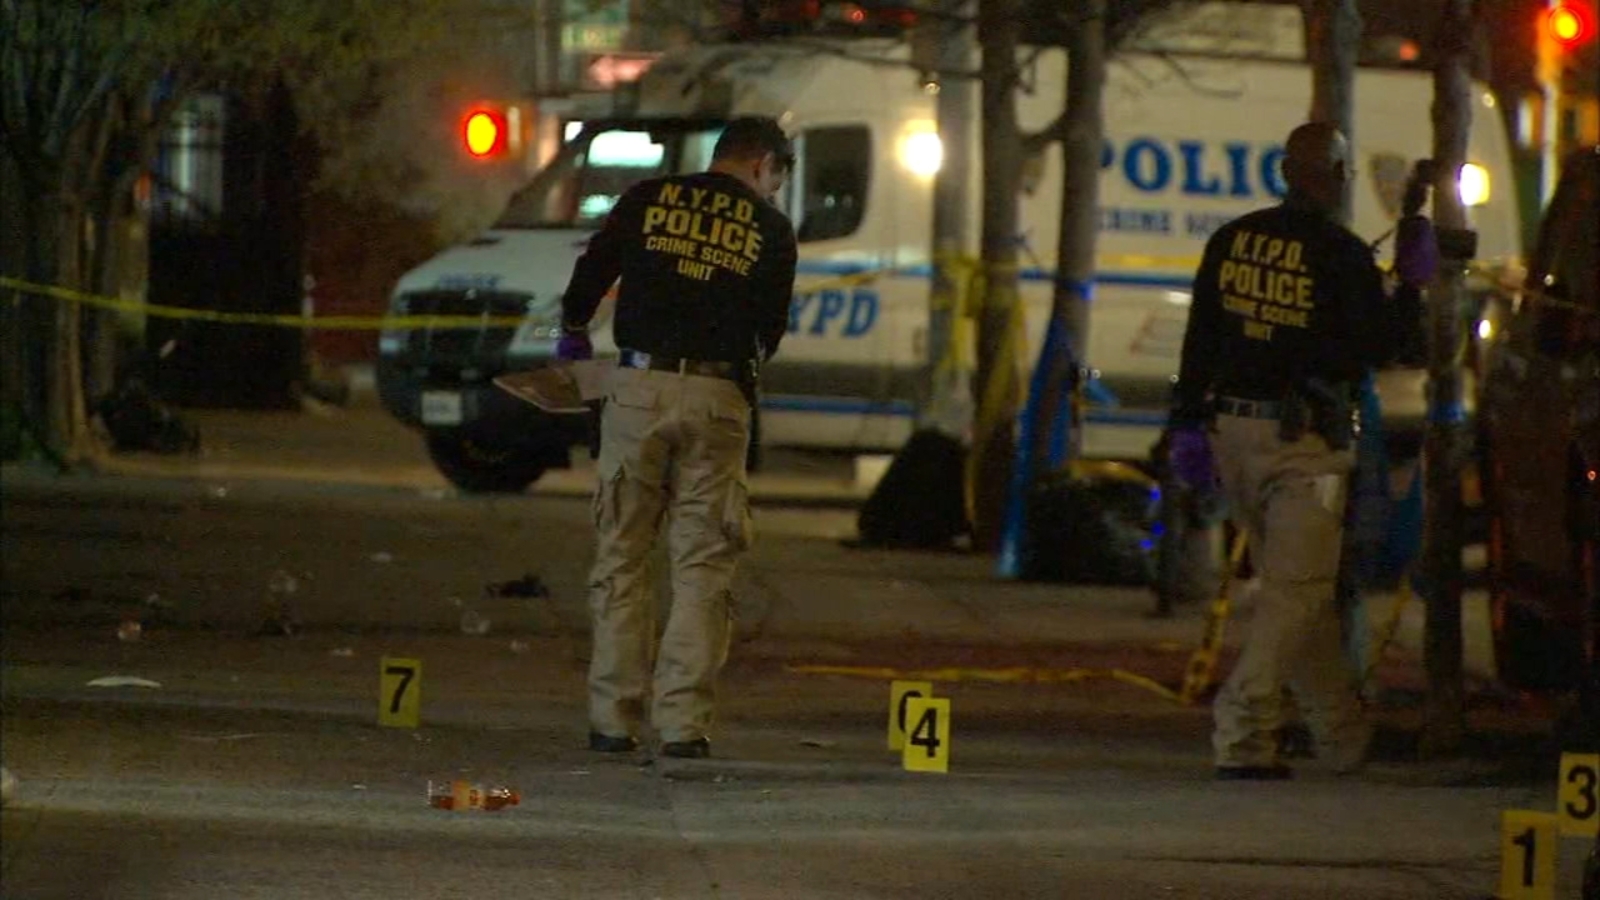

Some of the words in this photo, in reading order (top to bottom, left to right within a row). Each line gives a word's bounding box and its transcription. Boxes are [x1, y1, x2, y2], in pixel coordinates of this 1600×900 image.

[1100, 136, 1288, 198] OLIC
[659, 183, 759, 228] N.Y.P.D.
[642, 207, 763, 262] POLICE
[644, 235, 699, 257] CRIME
[700, 246, 752, 277] SCENE
[1231, 231, 1306, 272] N.Y.P.D.
[676, 257, 717, 281] UNIT
[1219, 260, 1314, 308] POLICE
[788, 288, 880, 336] YPD
[385, 667, 414, 713] 7
[911, 708, 940, 757] 4
[1567, 765, 1596, 820] 3
[1513, 828, 1535, 887] 1
